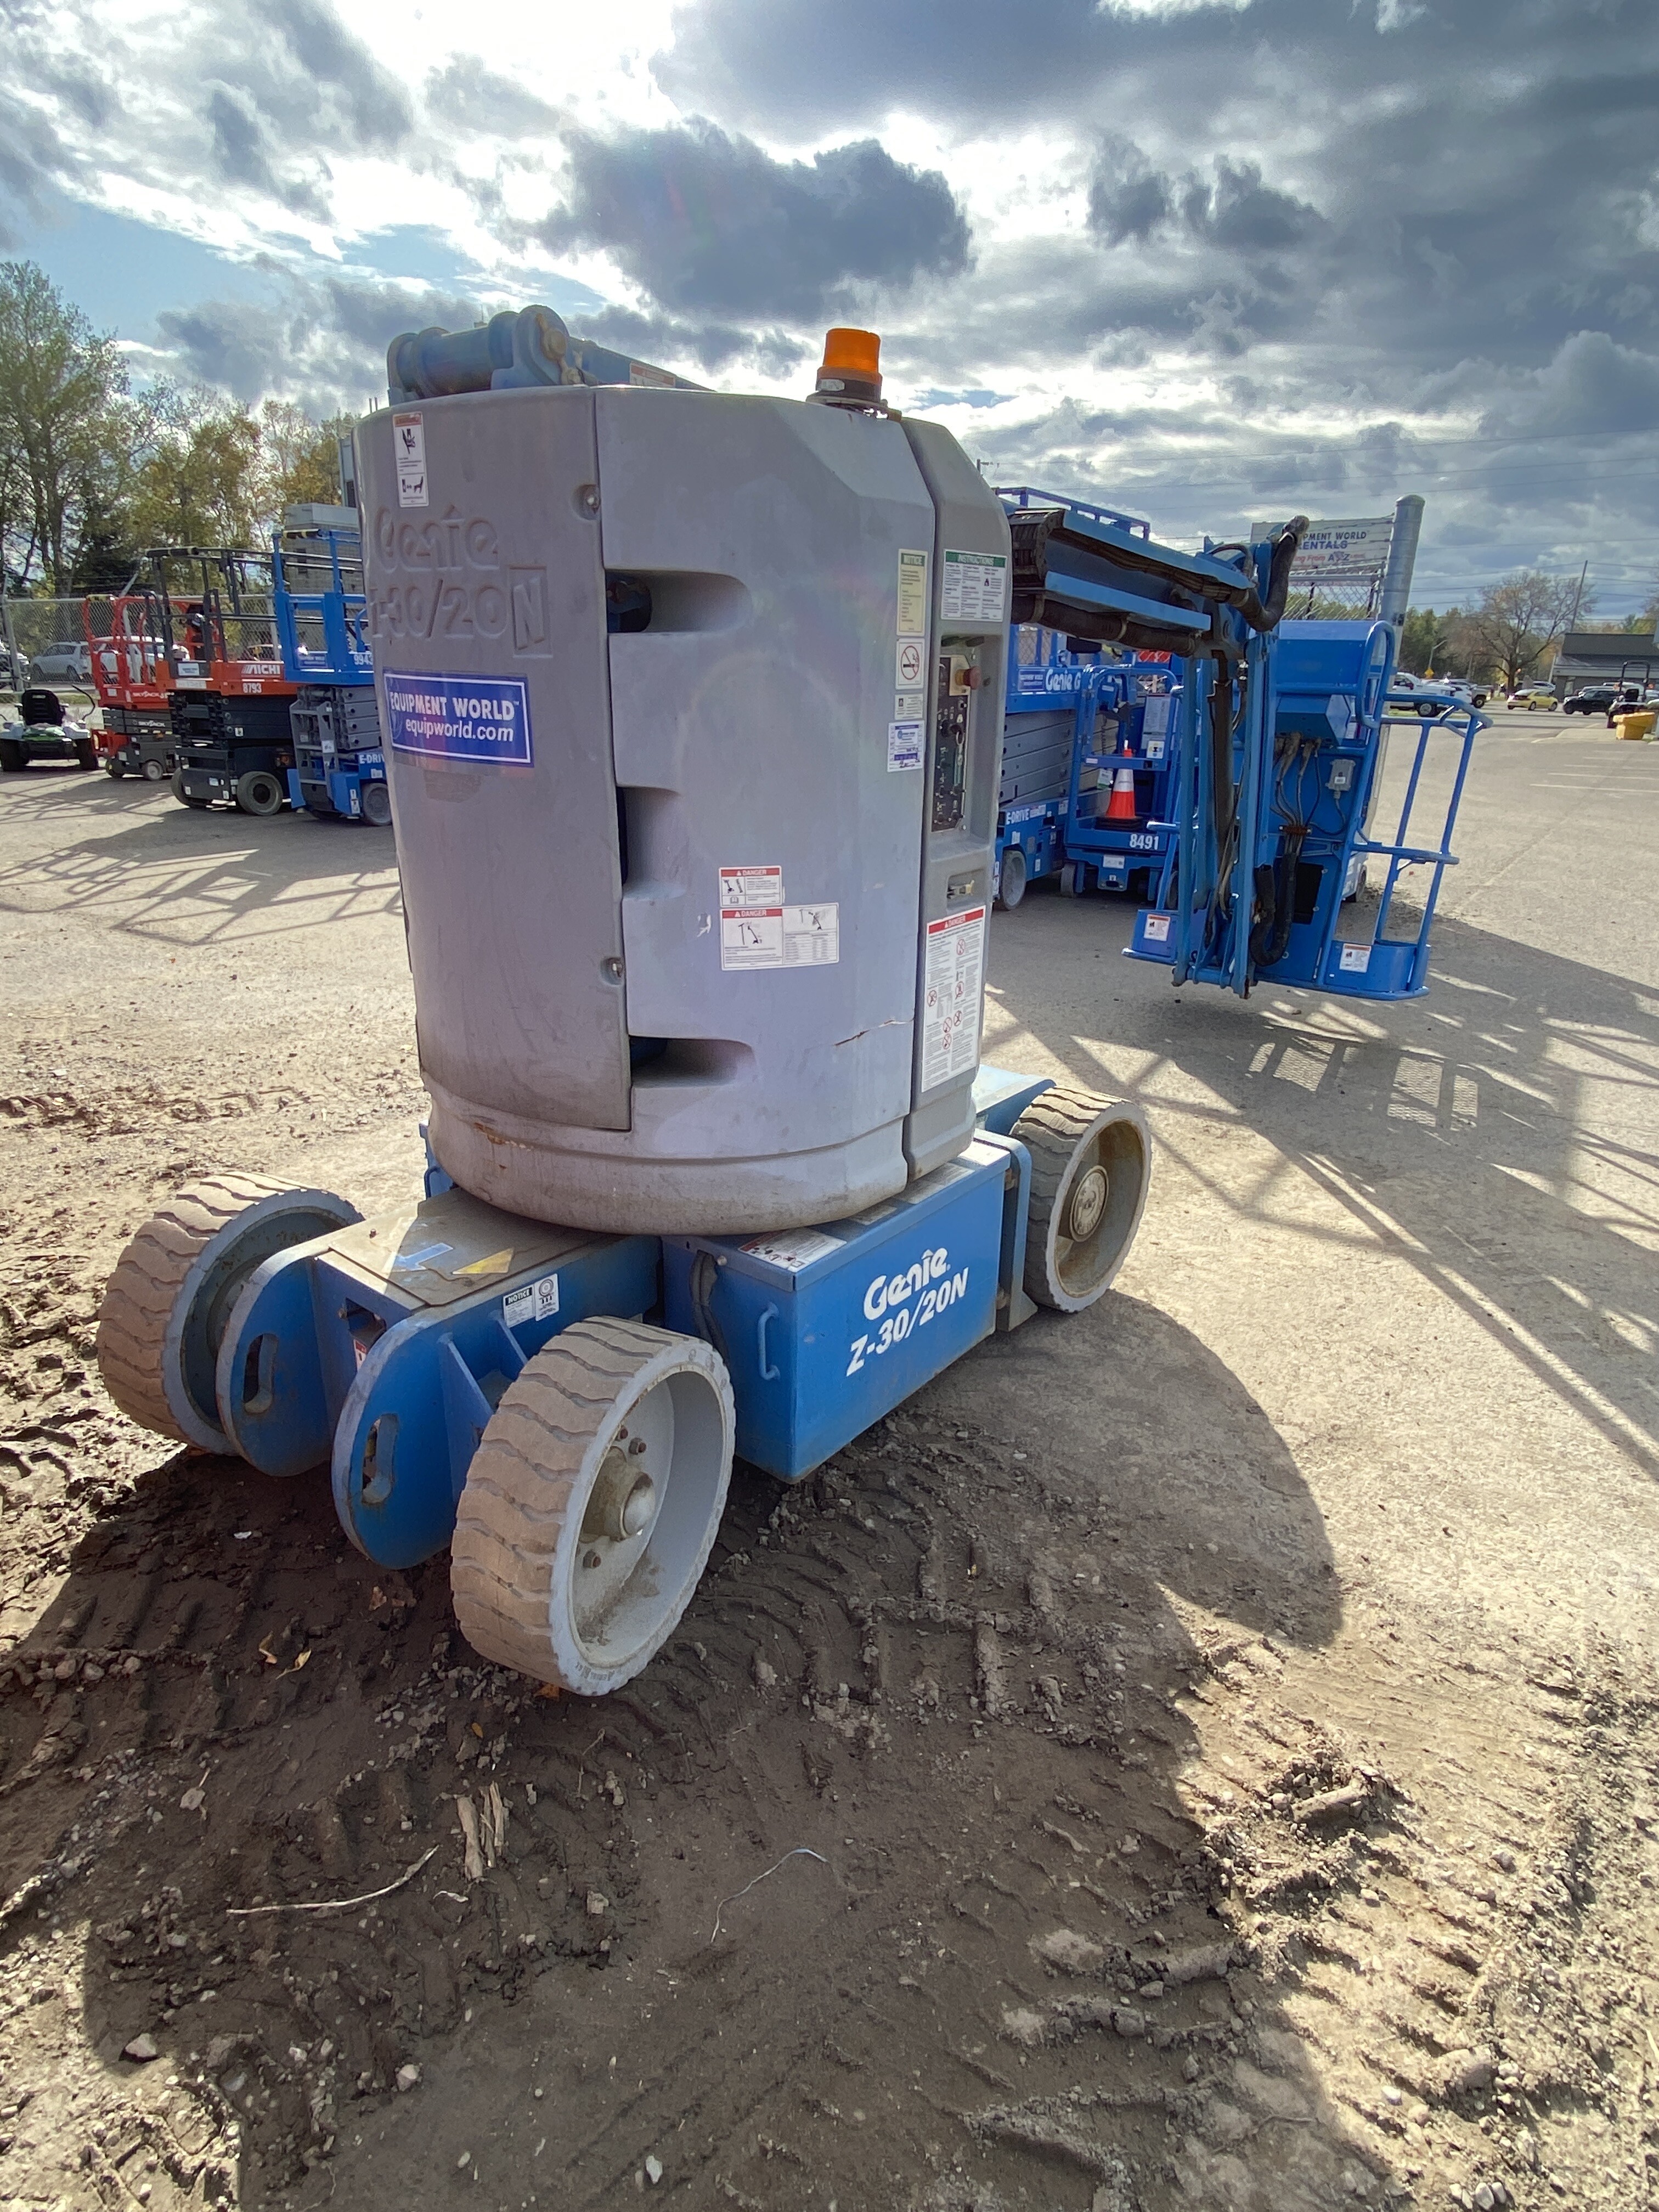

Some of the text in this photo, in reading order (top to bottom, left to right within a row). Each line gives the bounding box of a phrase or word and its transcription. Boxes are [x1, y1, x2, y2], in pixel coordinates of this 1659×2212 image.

[1300, 540, 1348, 550] ENTALS
[1336, 532, 1367, 540] WORLD
[242, 682, 262, 693] 8793
[1046, 669, 1073, 691] Genie
[390, 692, 515, 721] EQUIPMENT WORLD
[405, 717, 514, 742] equipworld.com
[1130, 833, 1159, 850] 8491
[864, 1248, 948, 1320] Genie
[508, 1289, 530, 1304] NOTICE
[847, 1267, 969, 1377] Z-30/20N
